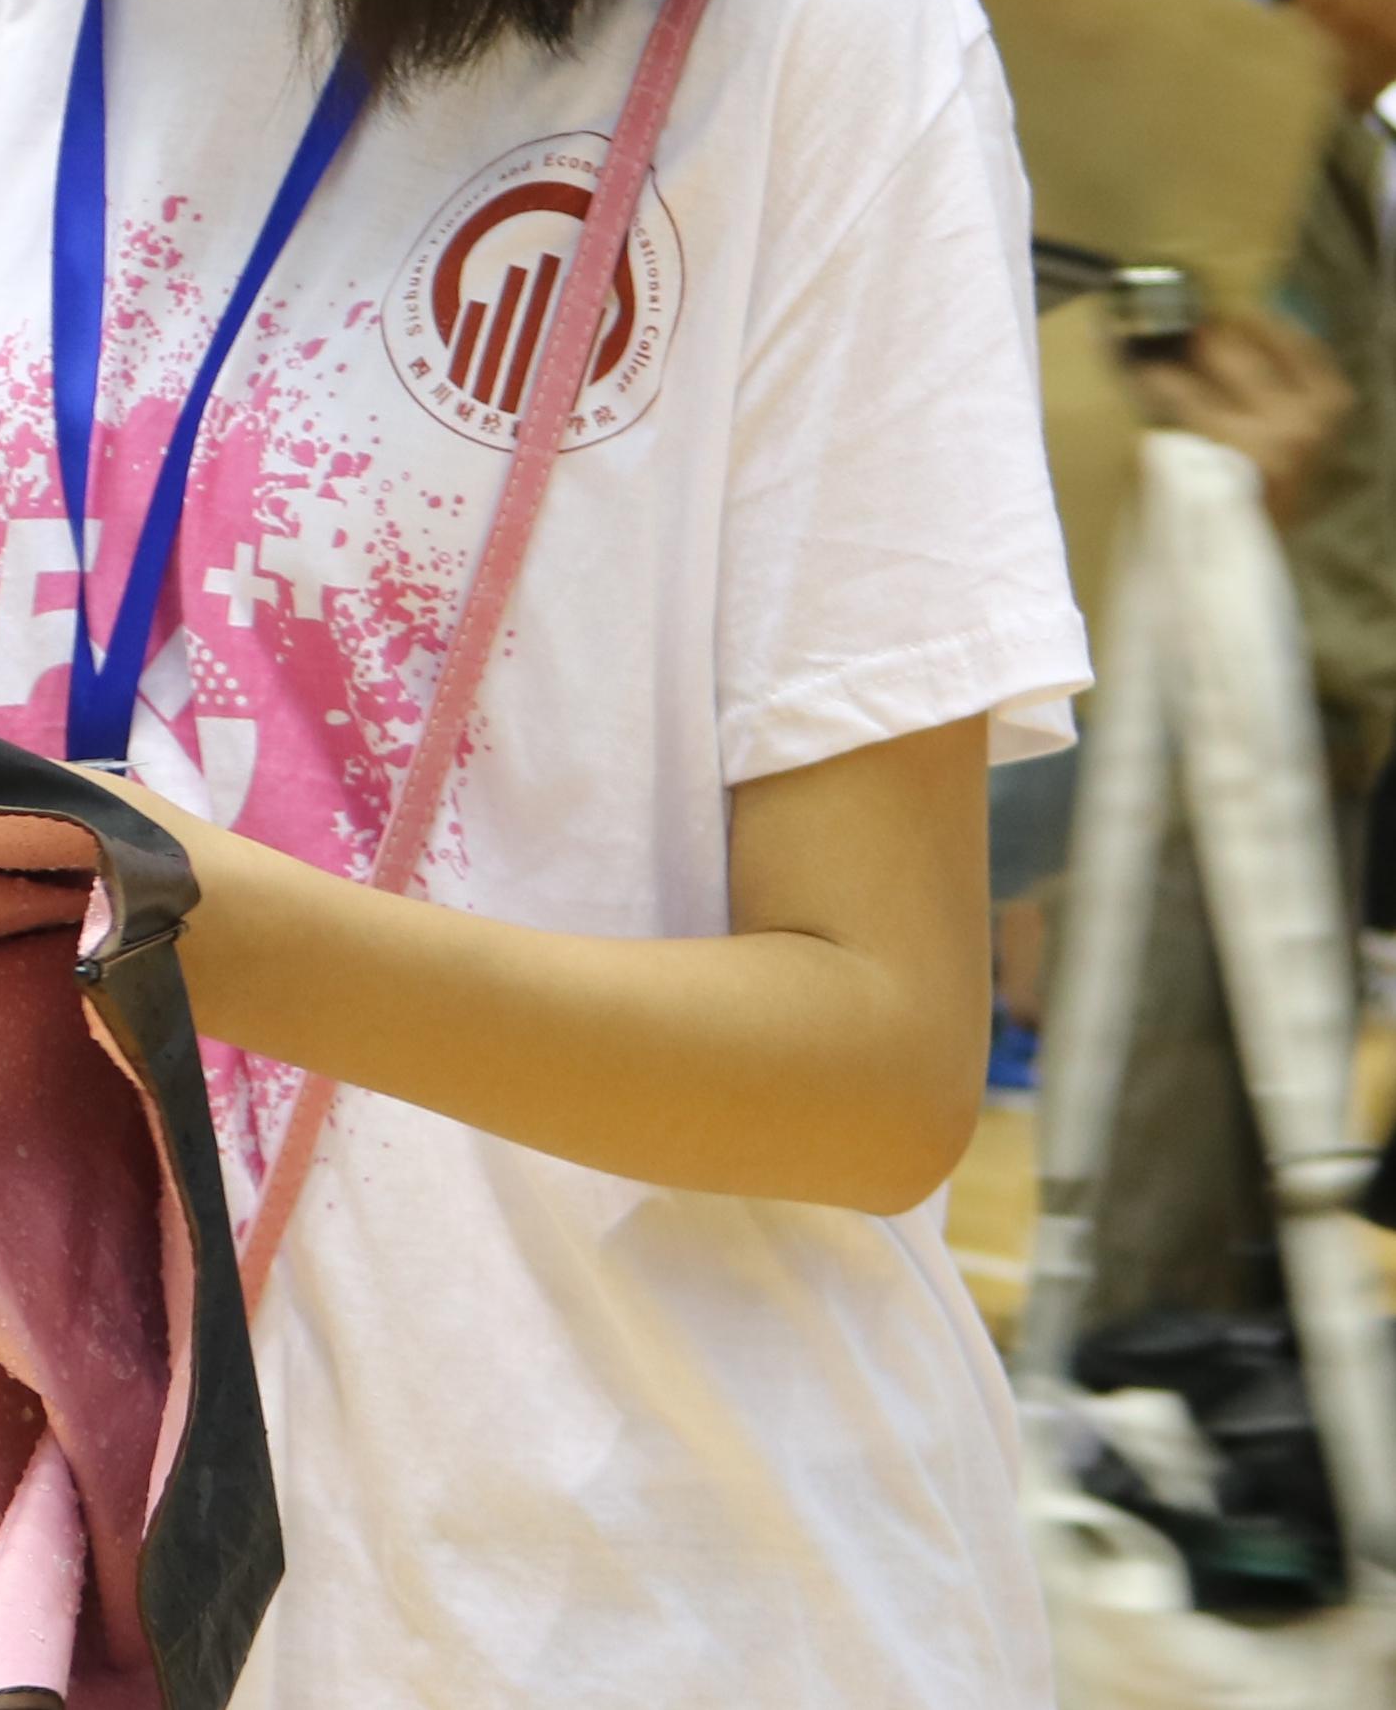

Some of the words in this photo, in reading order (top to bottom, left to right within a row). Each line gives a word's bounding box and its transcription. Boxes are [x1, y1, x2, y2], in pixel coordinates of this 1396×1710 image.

[408, 356, 617, 436] 四川财经学院
